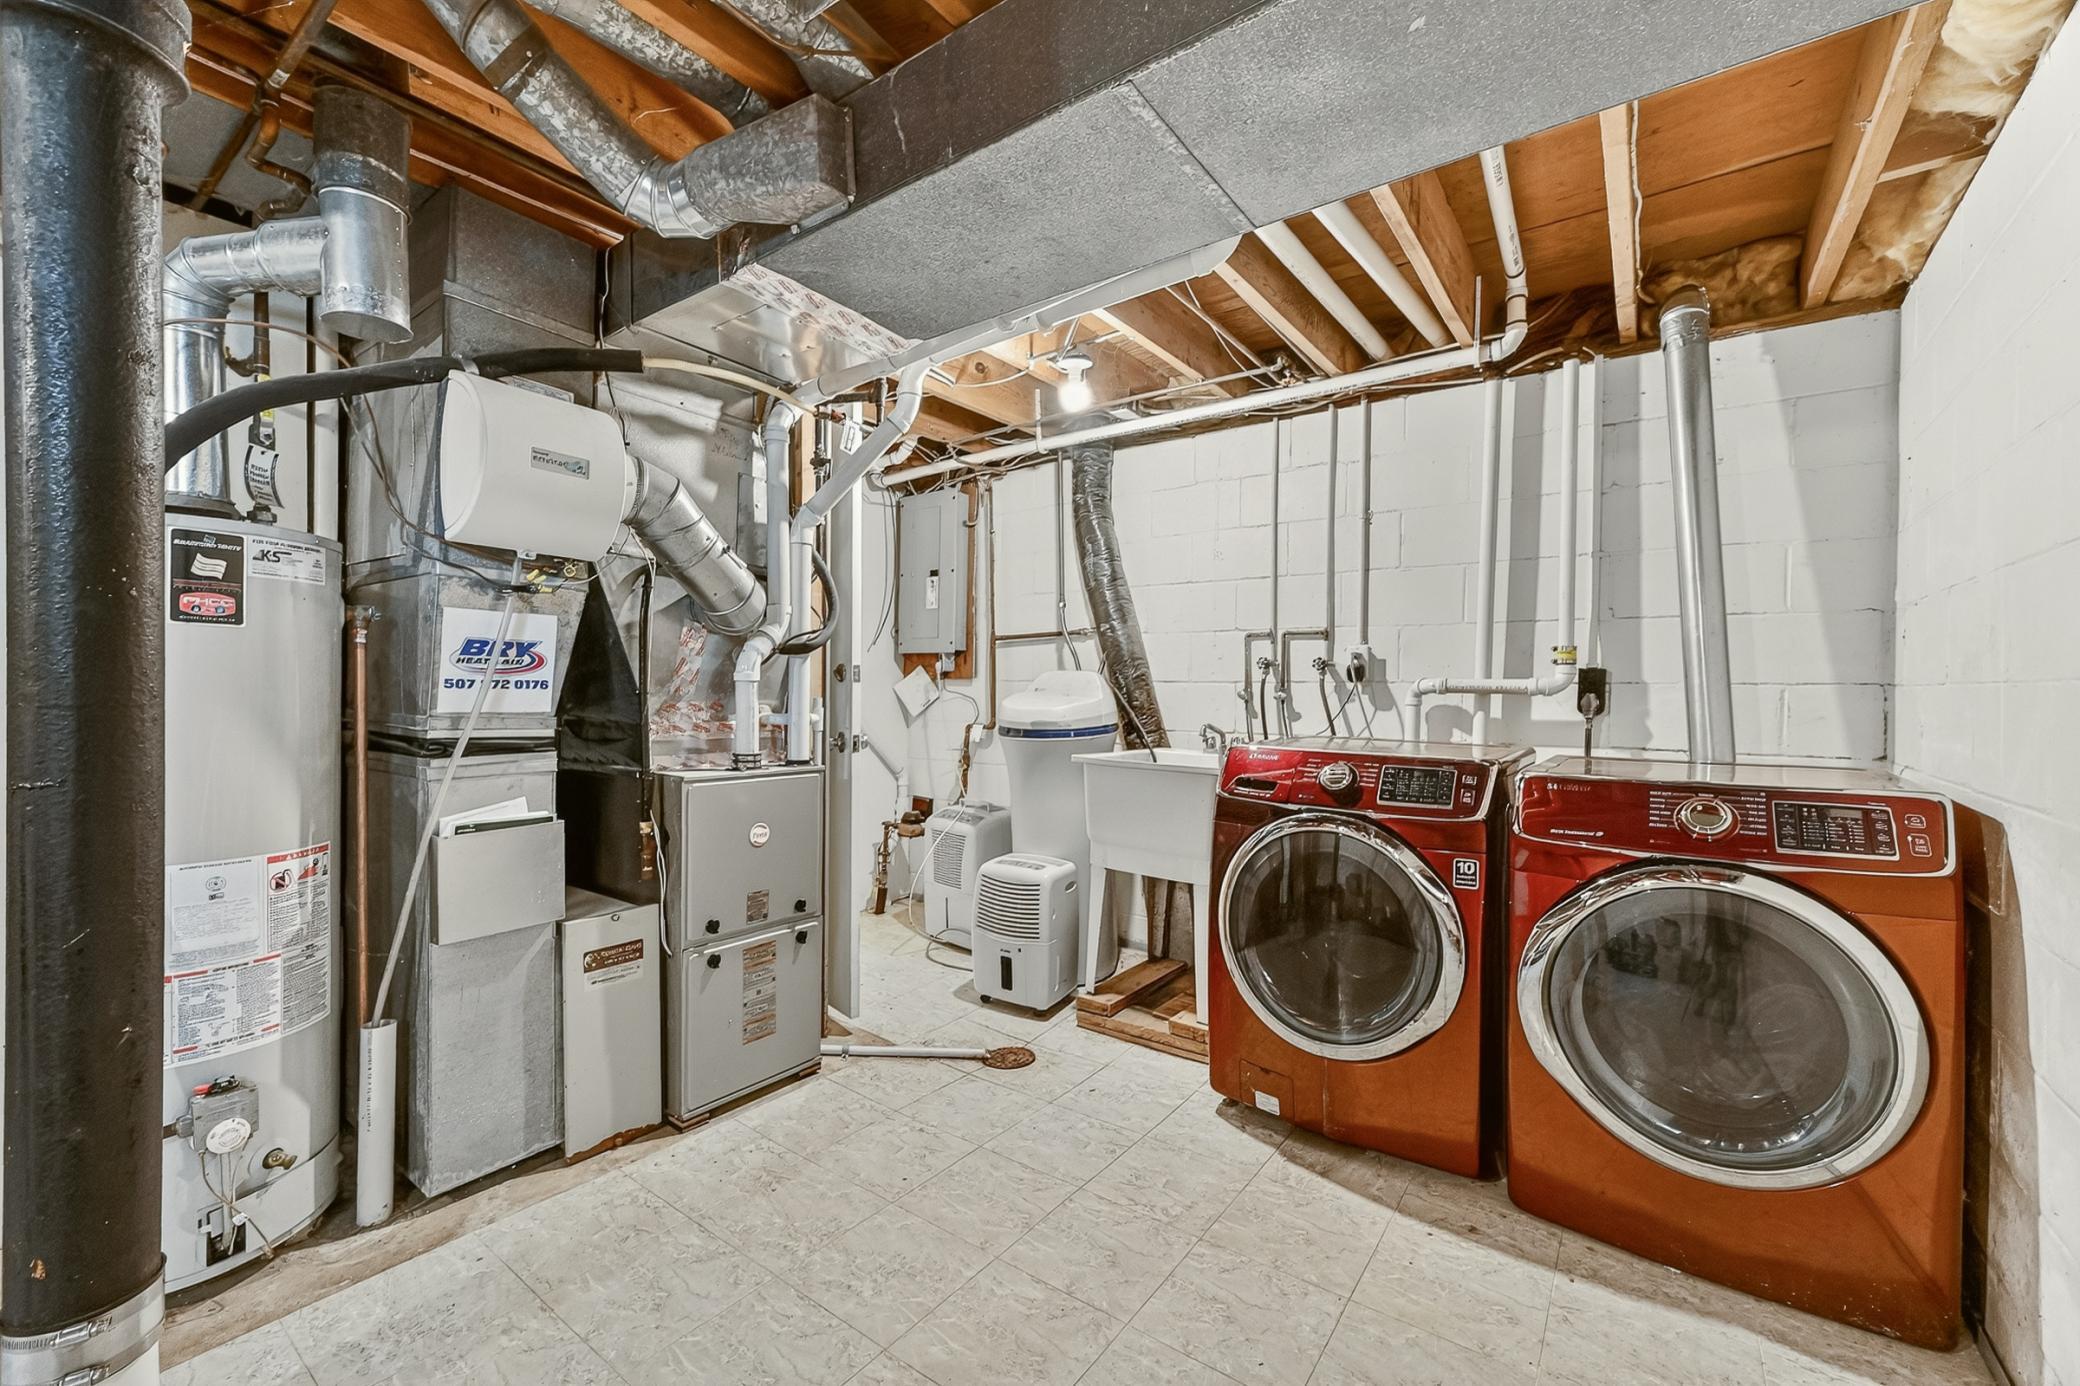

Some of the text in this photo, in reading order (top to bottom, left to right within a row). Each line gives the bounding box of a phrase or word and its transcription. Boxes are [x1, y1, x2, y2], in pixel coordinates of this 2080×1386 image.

[459, 639, 539, 658] BRY
[443, 678, 550, 690] 507 72 0176
[1457, 862, 1475, 875] 10
